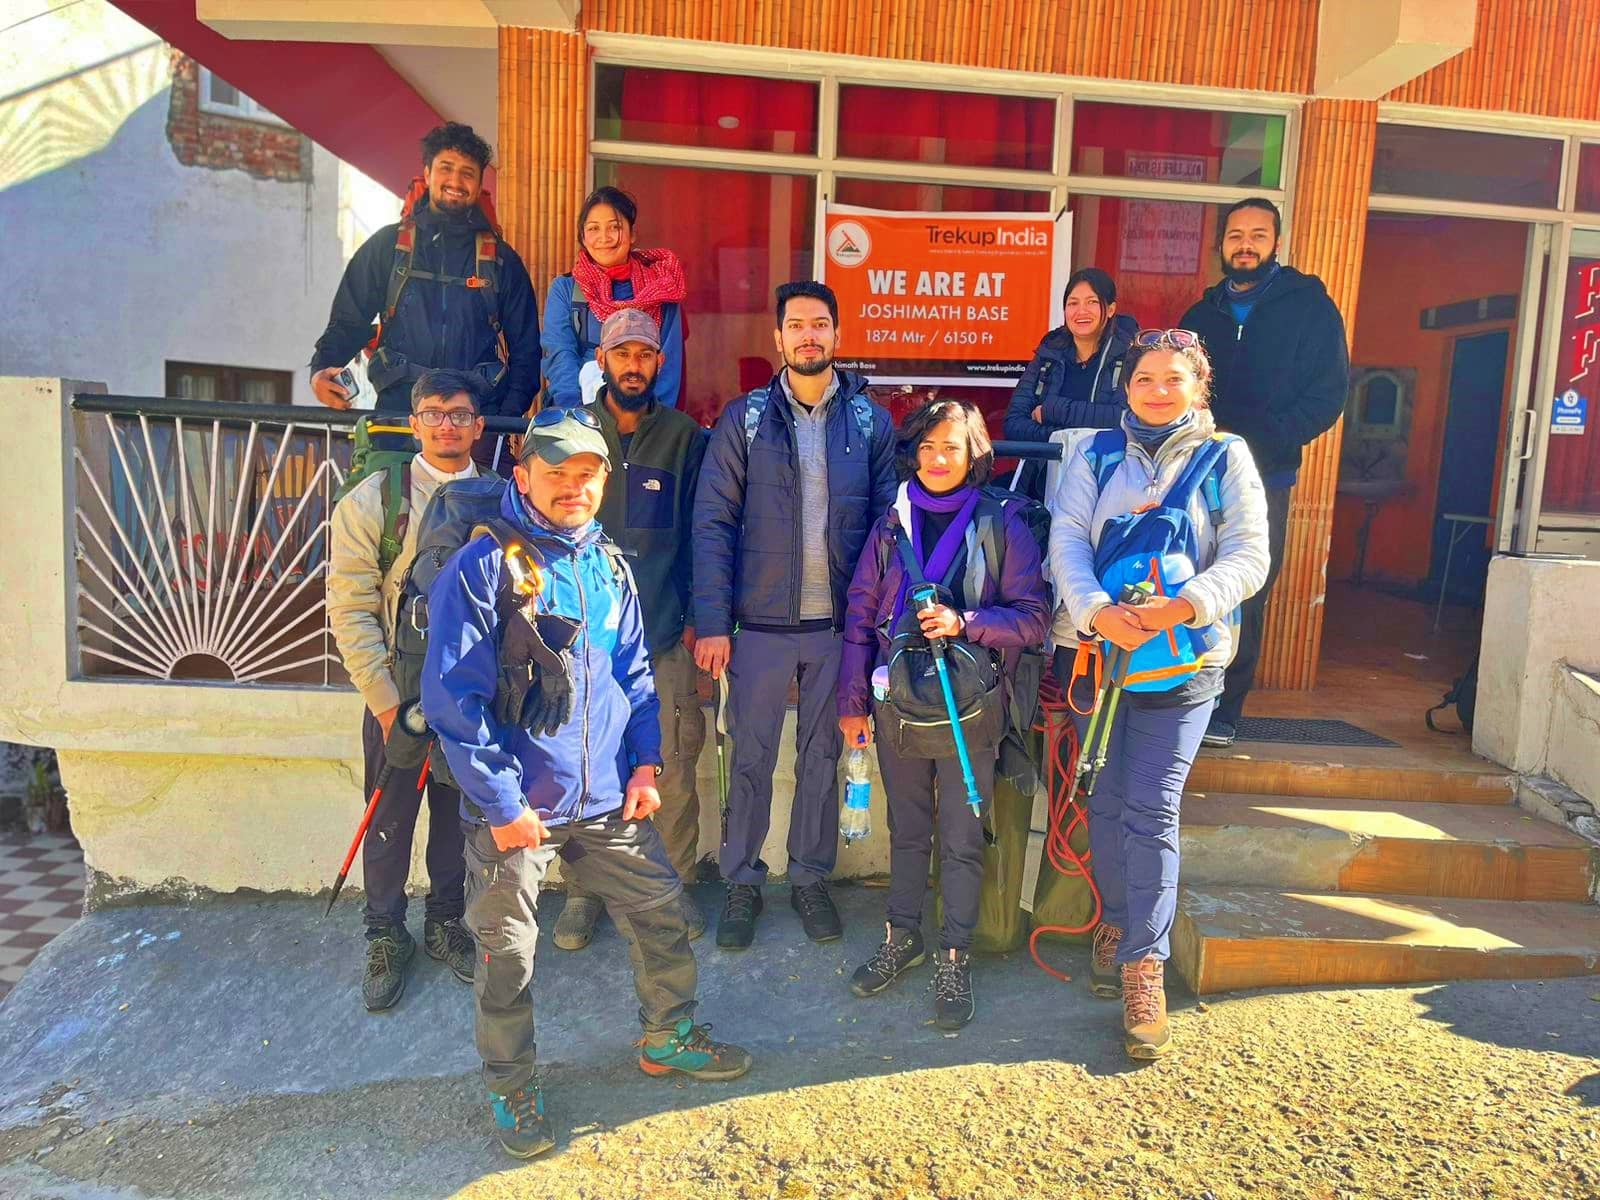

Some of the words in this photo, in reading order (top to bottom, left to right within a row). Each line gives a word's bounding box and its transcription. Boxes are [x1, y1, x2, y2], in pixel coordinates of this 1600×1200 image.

[926, 226, 1048, 247] TrekupIndia
[867, 269, 907, 295] WE
[915, 271, 965, 296] ARE
[973, 272, 1005, 297] AT
[859, 303, 961, 320] JOSHIMATH
[967, 306, 1009, 321] BASE
[865, 329, 897, 342] 1874
[902, 331, 926, 343] Mtr
[928, 330, 939, 346] /
[944, 331, 977, 344] 6150
[981, 332, 993, 344] Ft
[832, 361, 858, 369] himath
[859, 362, 876, 370] Base
